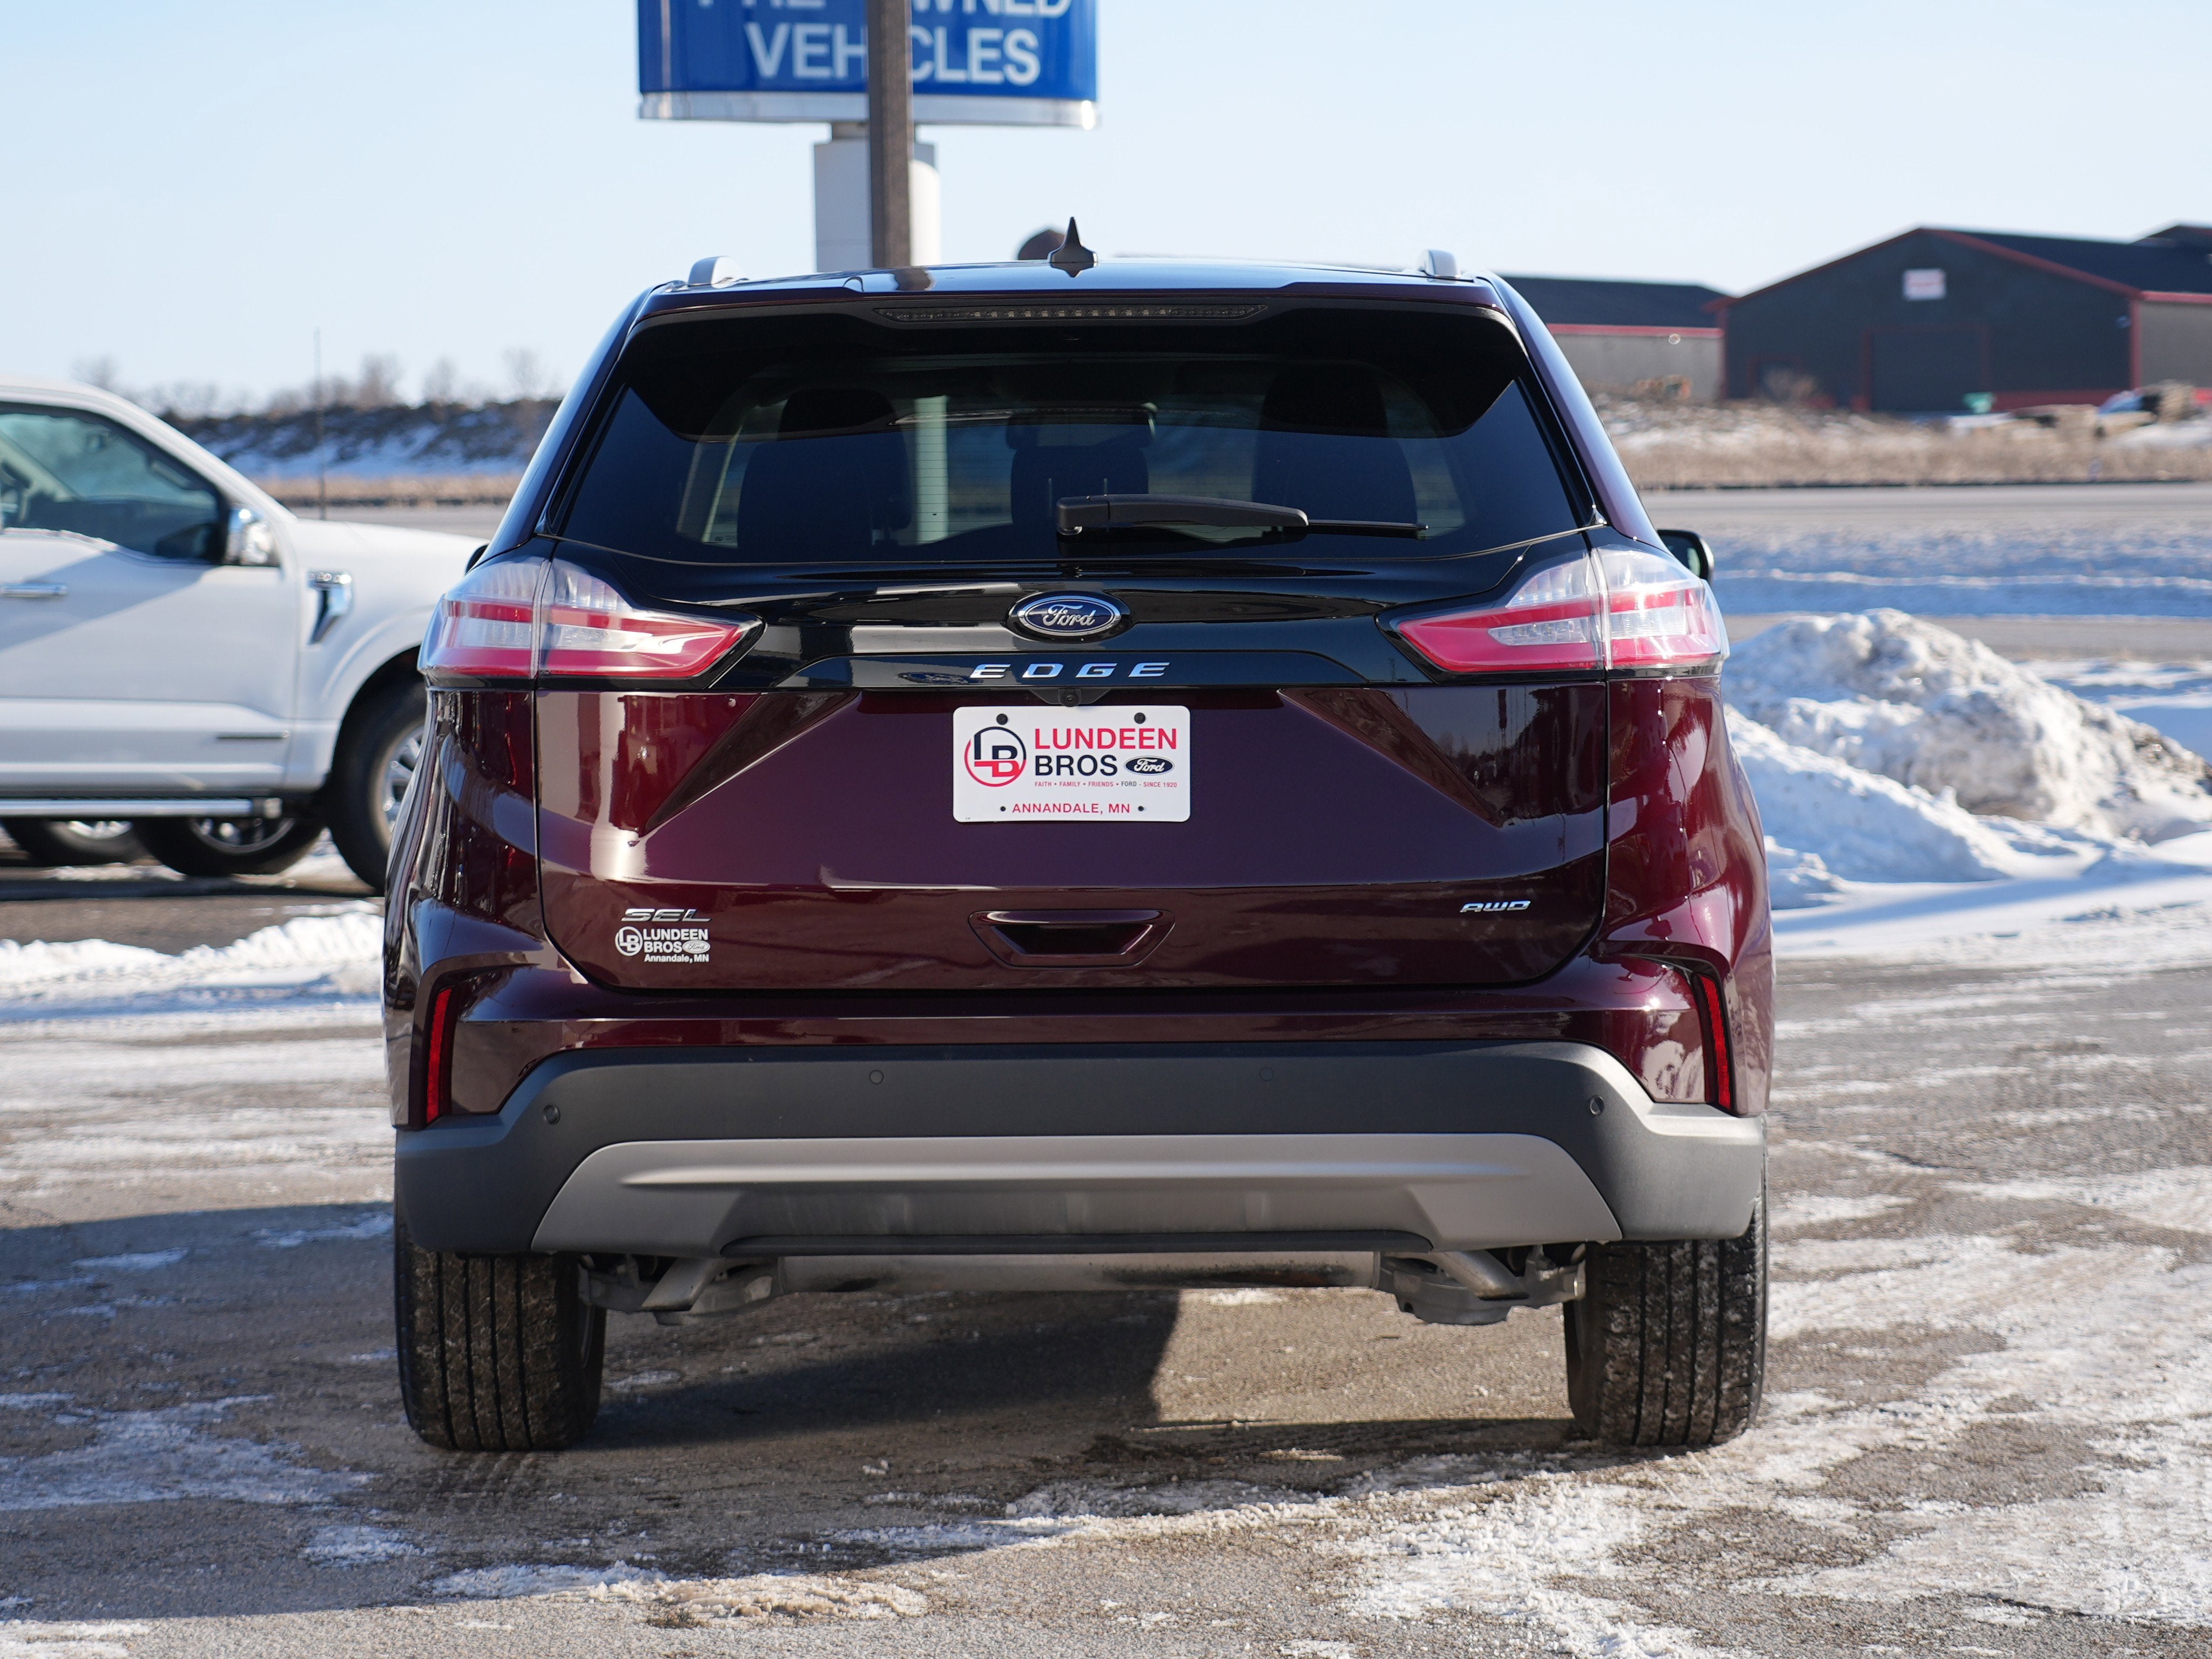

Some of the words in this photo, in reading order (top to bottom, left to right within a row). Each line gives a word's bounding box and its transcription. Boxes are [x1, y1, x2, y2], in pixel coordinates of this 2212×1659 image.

[745, 22, 1041, 85] VEHCLES
[1042, 604, 1096, 626] Ford
[969, 662, 1170, 678] EDGE
[1035, 728, 1176, 750] LUNDEEN
[1035, 754, 1118, 776] BROS
[1133, 759, 1165, 773] Ford
[1011, 803, 1103, 815] ANNANDALE,
[1108, 804, 1130, 813] MN
[1459, 900, 1531, 913] AWD
[621, 908, 711, 922] SEL
[643, 928, 709, 941] LUNDEEN
[643, 941, 683, 953] BROS
[644, 954, 693, 964] Annandale,
[693, 954, 709, 962] MN
